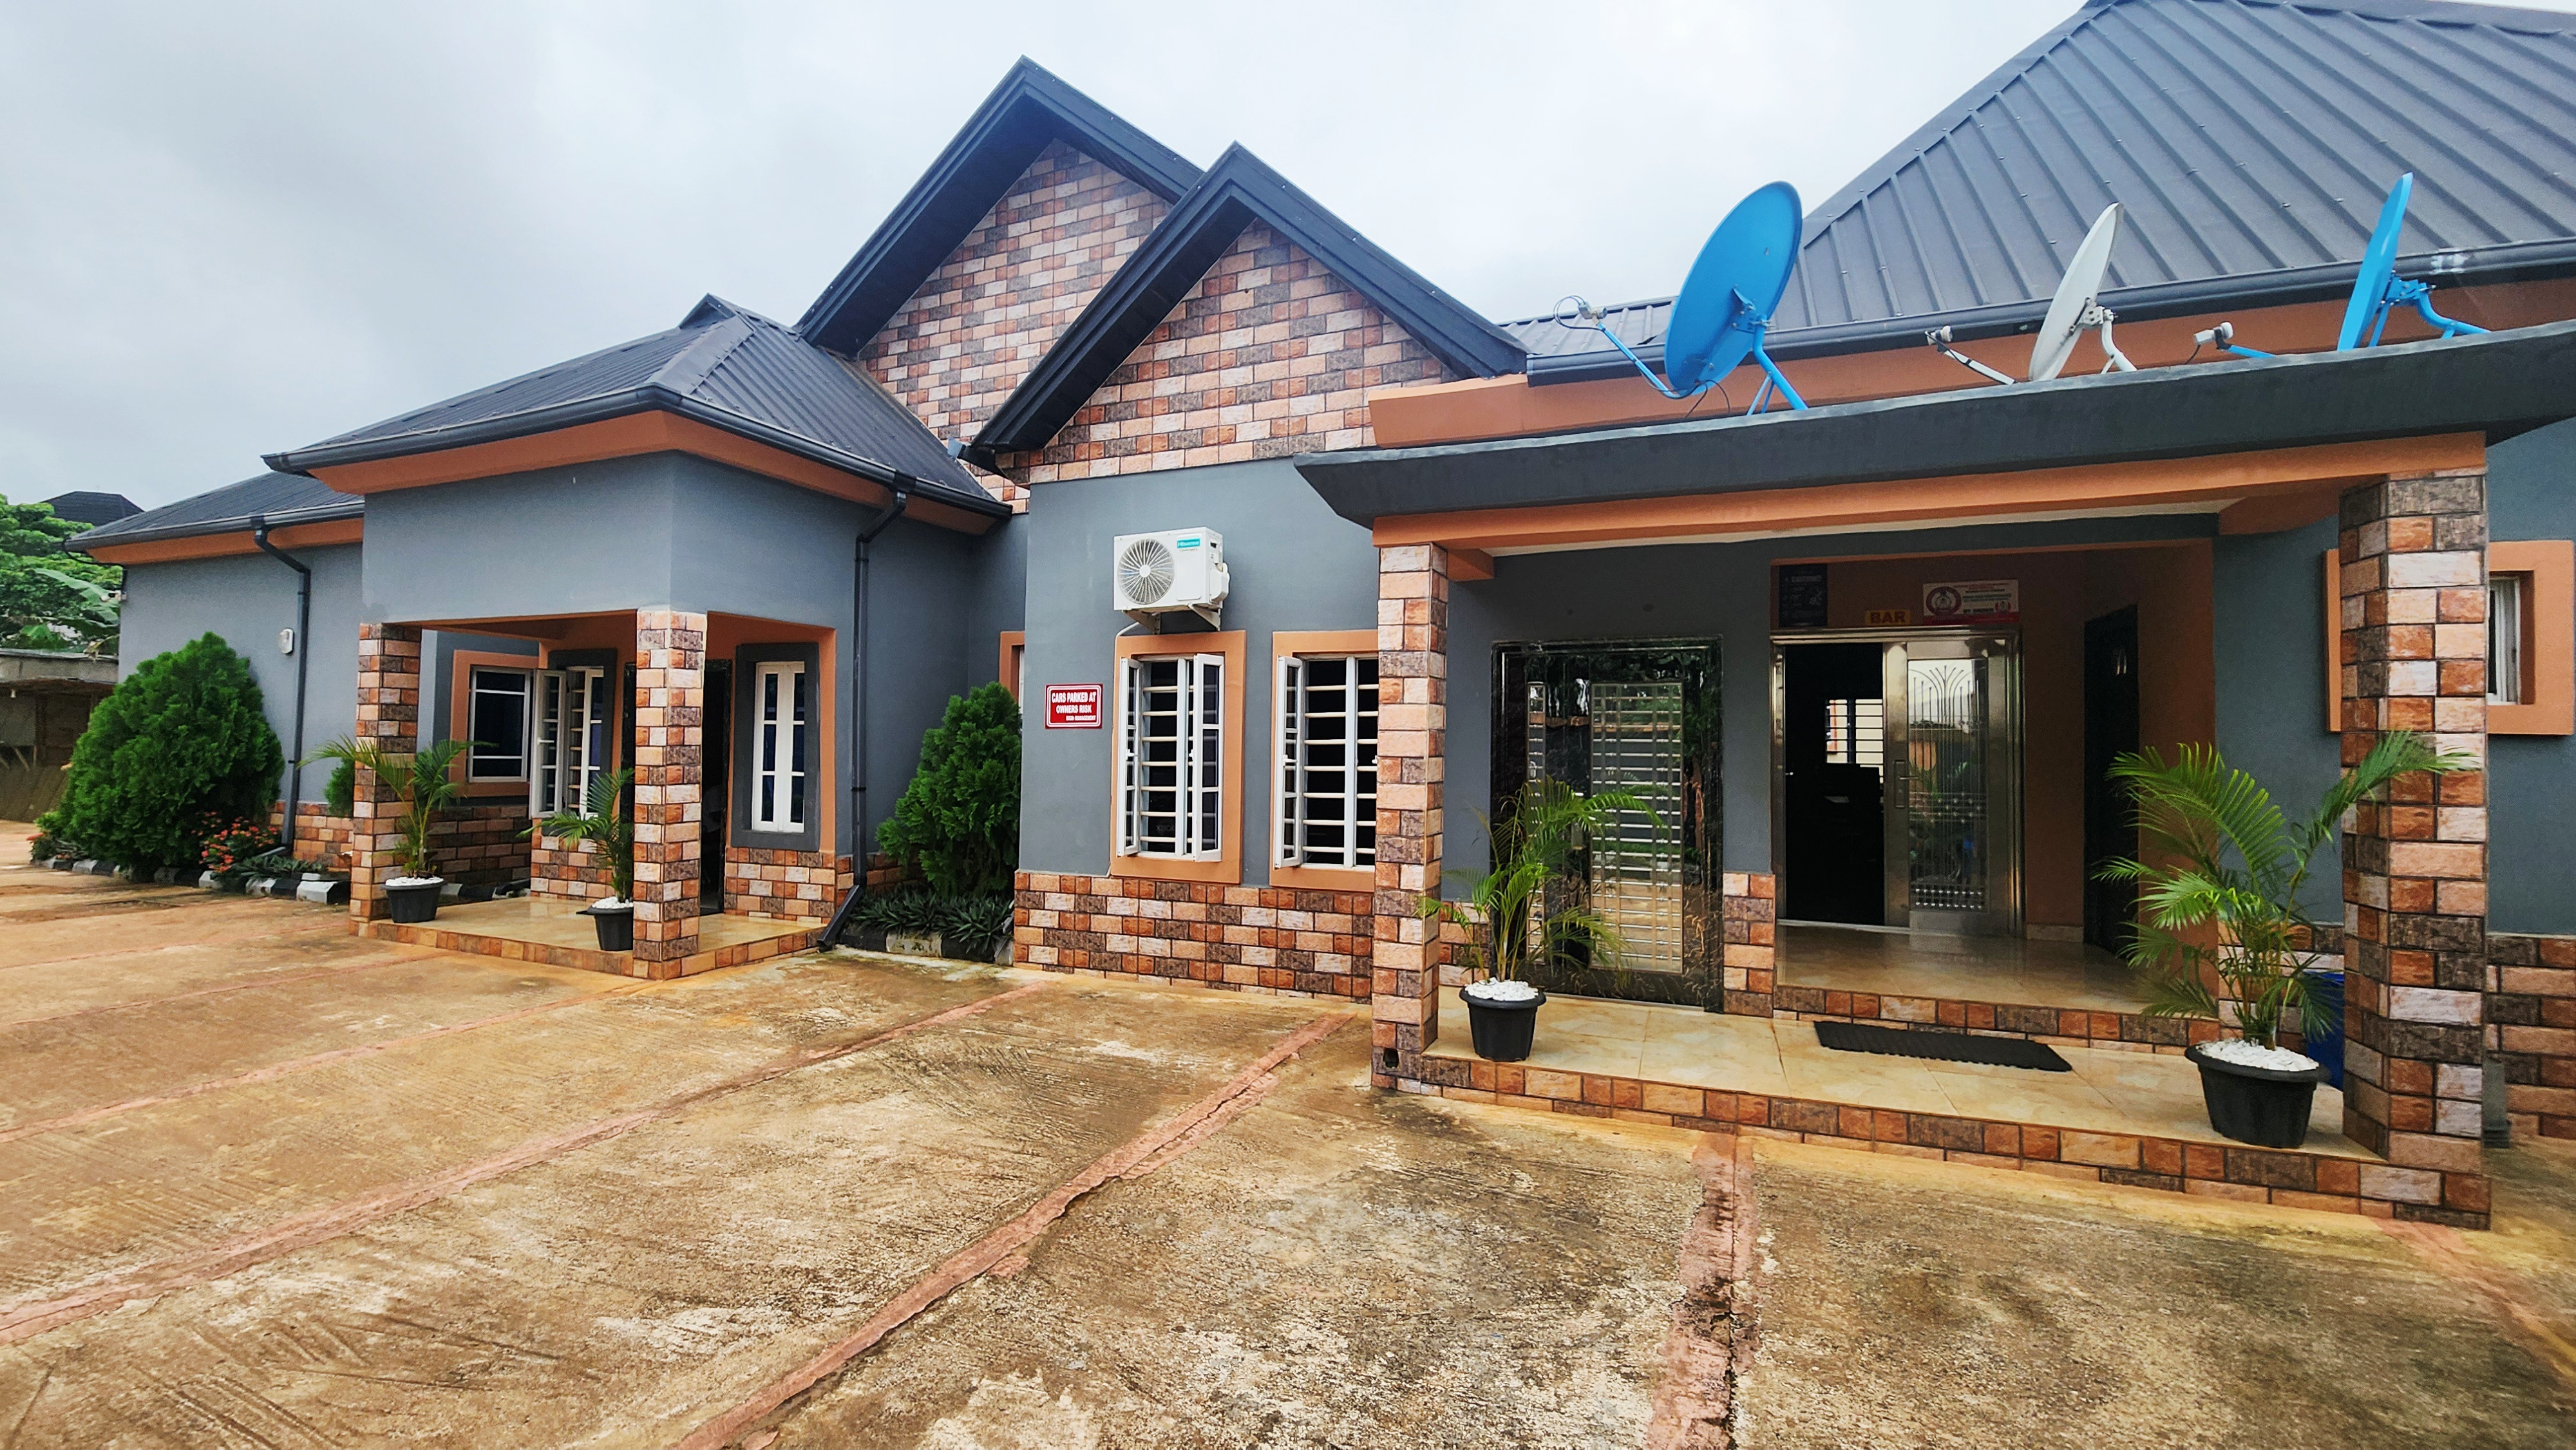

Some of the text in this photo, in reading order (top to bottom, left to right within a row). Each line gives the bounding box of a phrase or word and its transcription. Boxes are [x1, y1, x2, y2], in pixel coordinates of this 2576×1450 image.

[1871, 611, 1906, 624] BAR
[1052, 692, 1096, 703] CARS PARKED AT
[1056, 704, 1092, 713] OWNERS RISK
